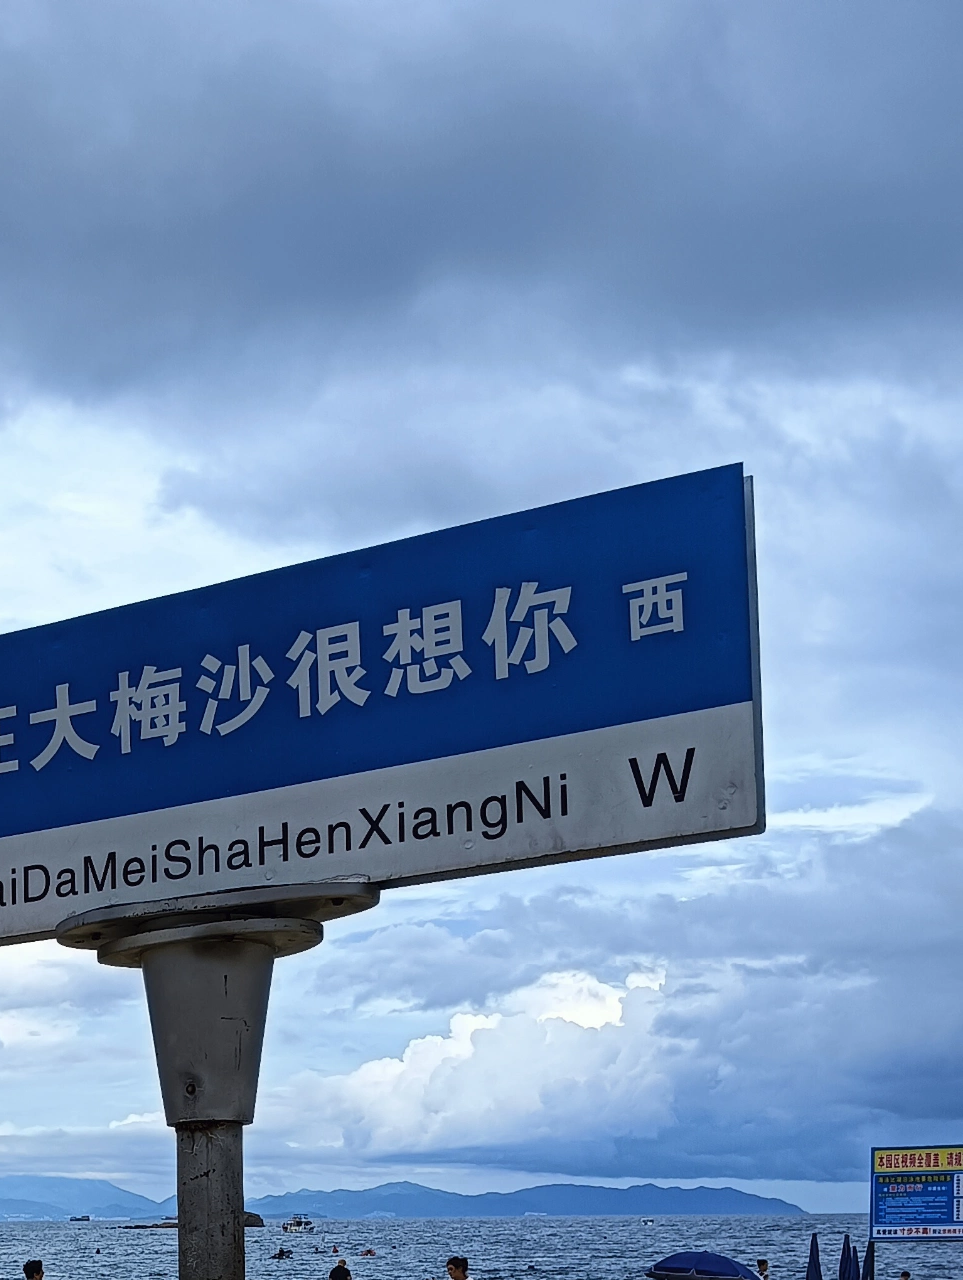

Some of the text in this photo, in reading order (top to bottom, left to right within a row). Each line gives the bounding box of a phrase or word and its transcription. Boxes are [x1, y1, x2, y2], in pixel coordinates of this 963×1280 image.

[622, 572, 689, 643] 西
[628, 747, 697, 808] W
[878, 1151, 963, 1169] 本园区视频全覆盖，请规
